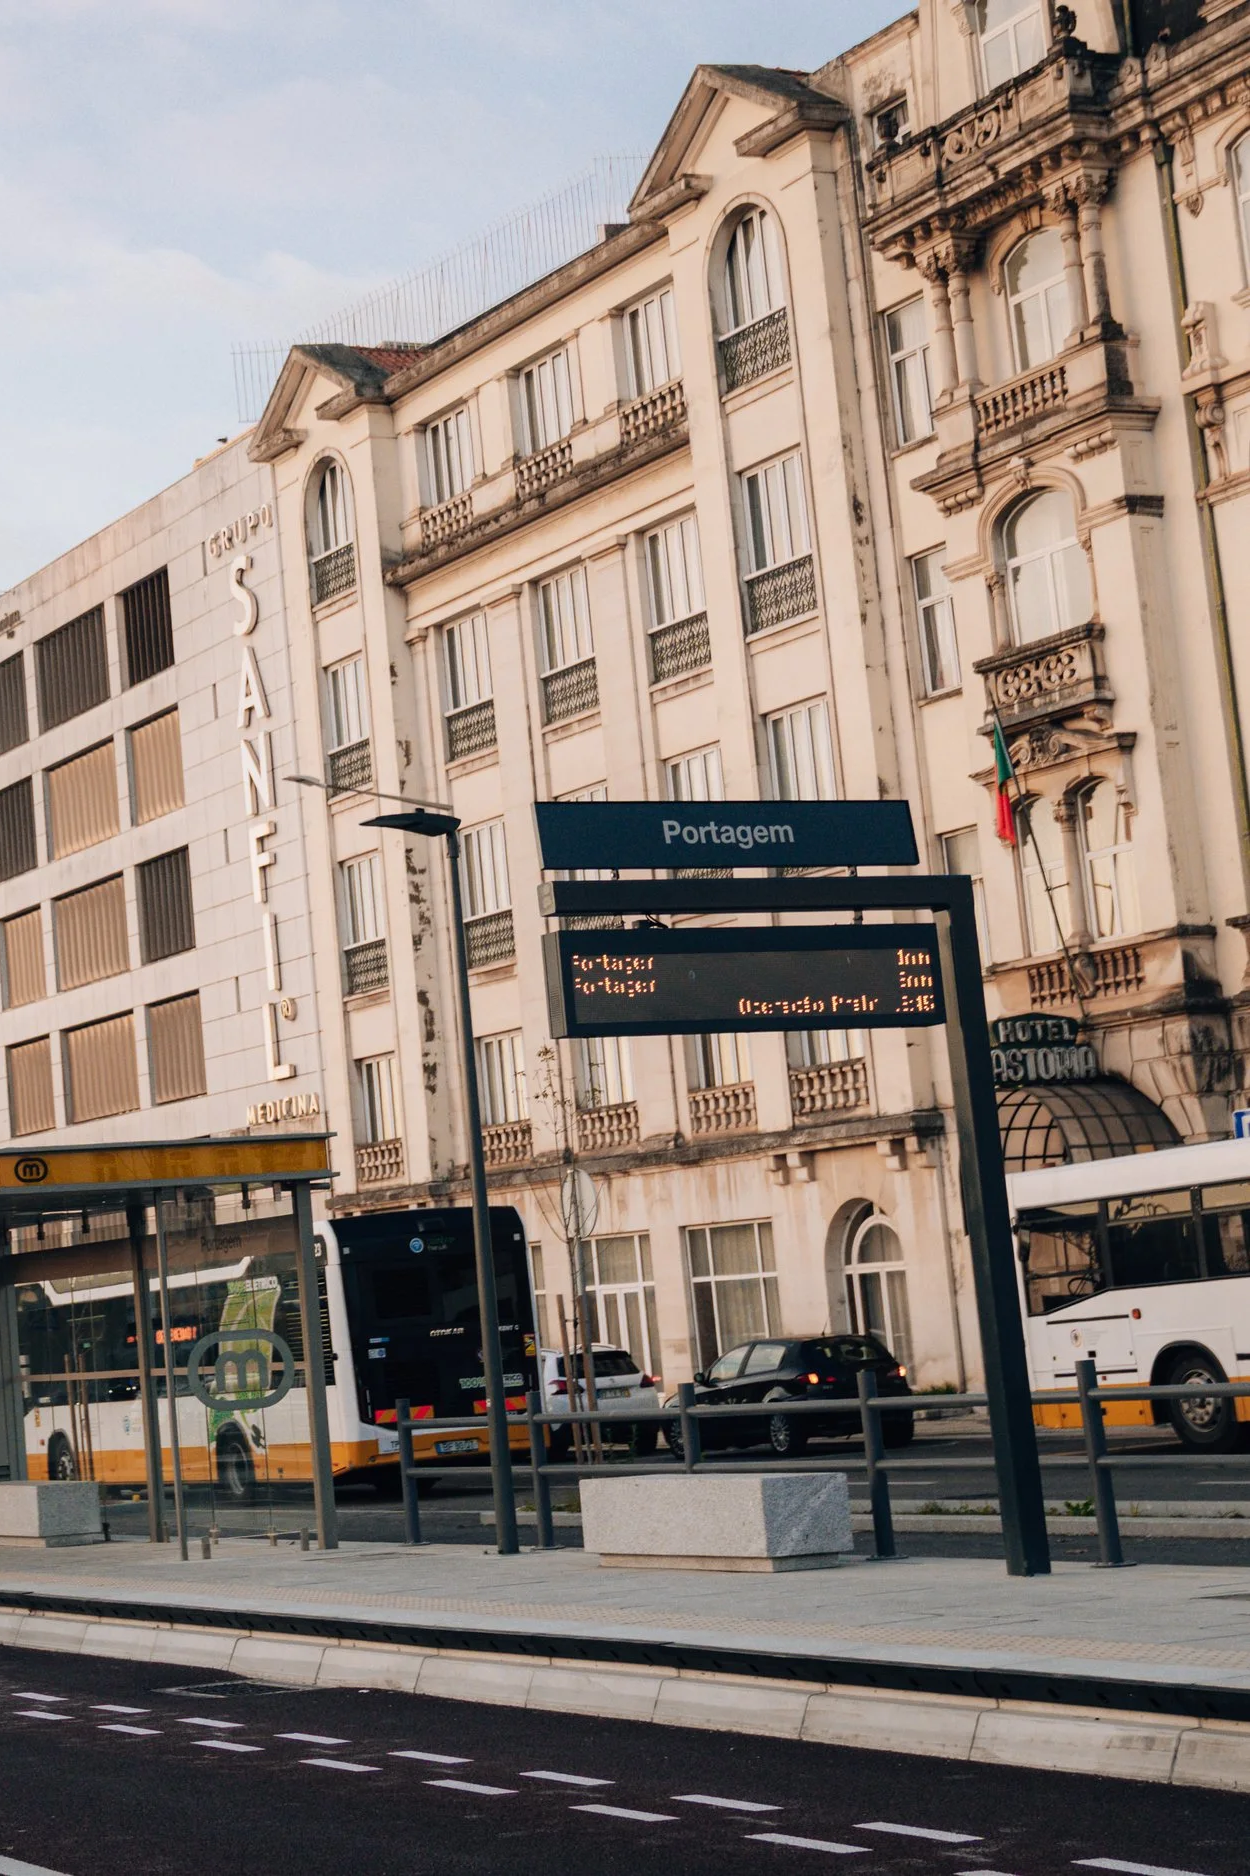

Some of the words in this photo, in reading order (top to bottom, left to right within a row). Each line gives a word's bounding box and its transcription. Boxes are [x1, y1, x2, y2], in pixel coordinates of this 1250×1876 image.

[209, 504, 273, 558] GRUPO
[662, 819, 795, 849] Portagem
[997, 1019, 1076, 1042] HOTEL
[990, 1046, 1098, 1082] ASTORIA
[246, 1092, 321, 1126] MEDICINA
